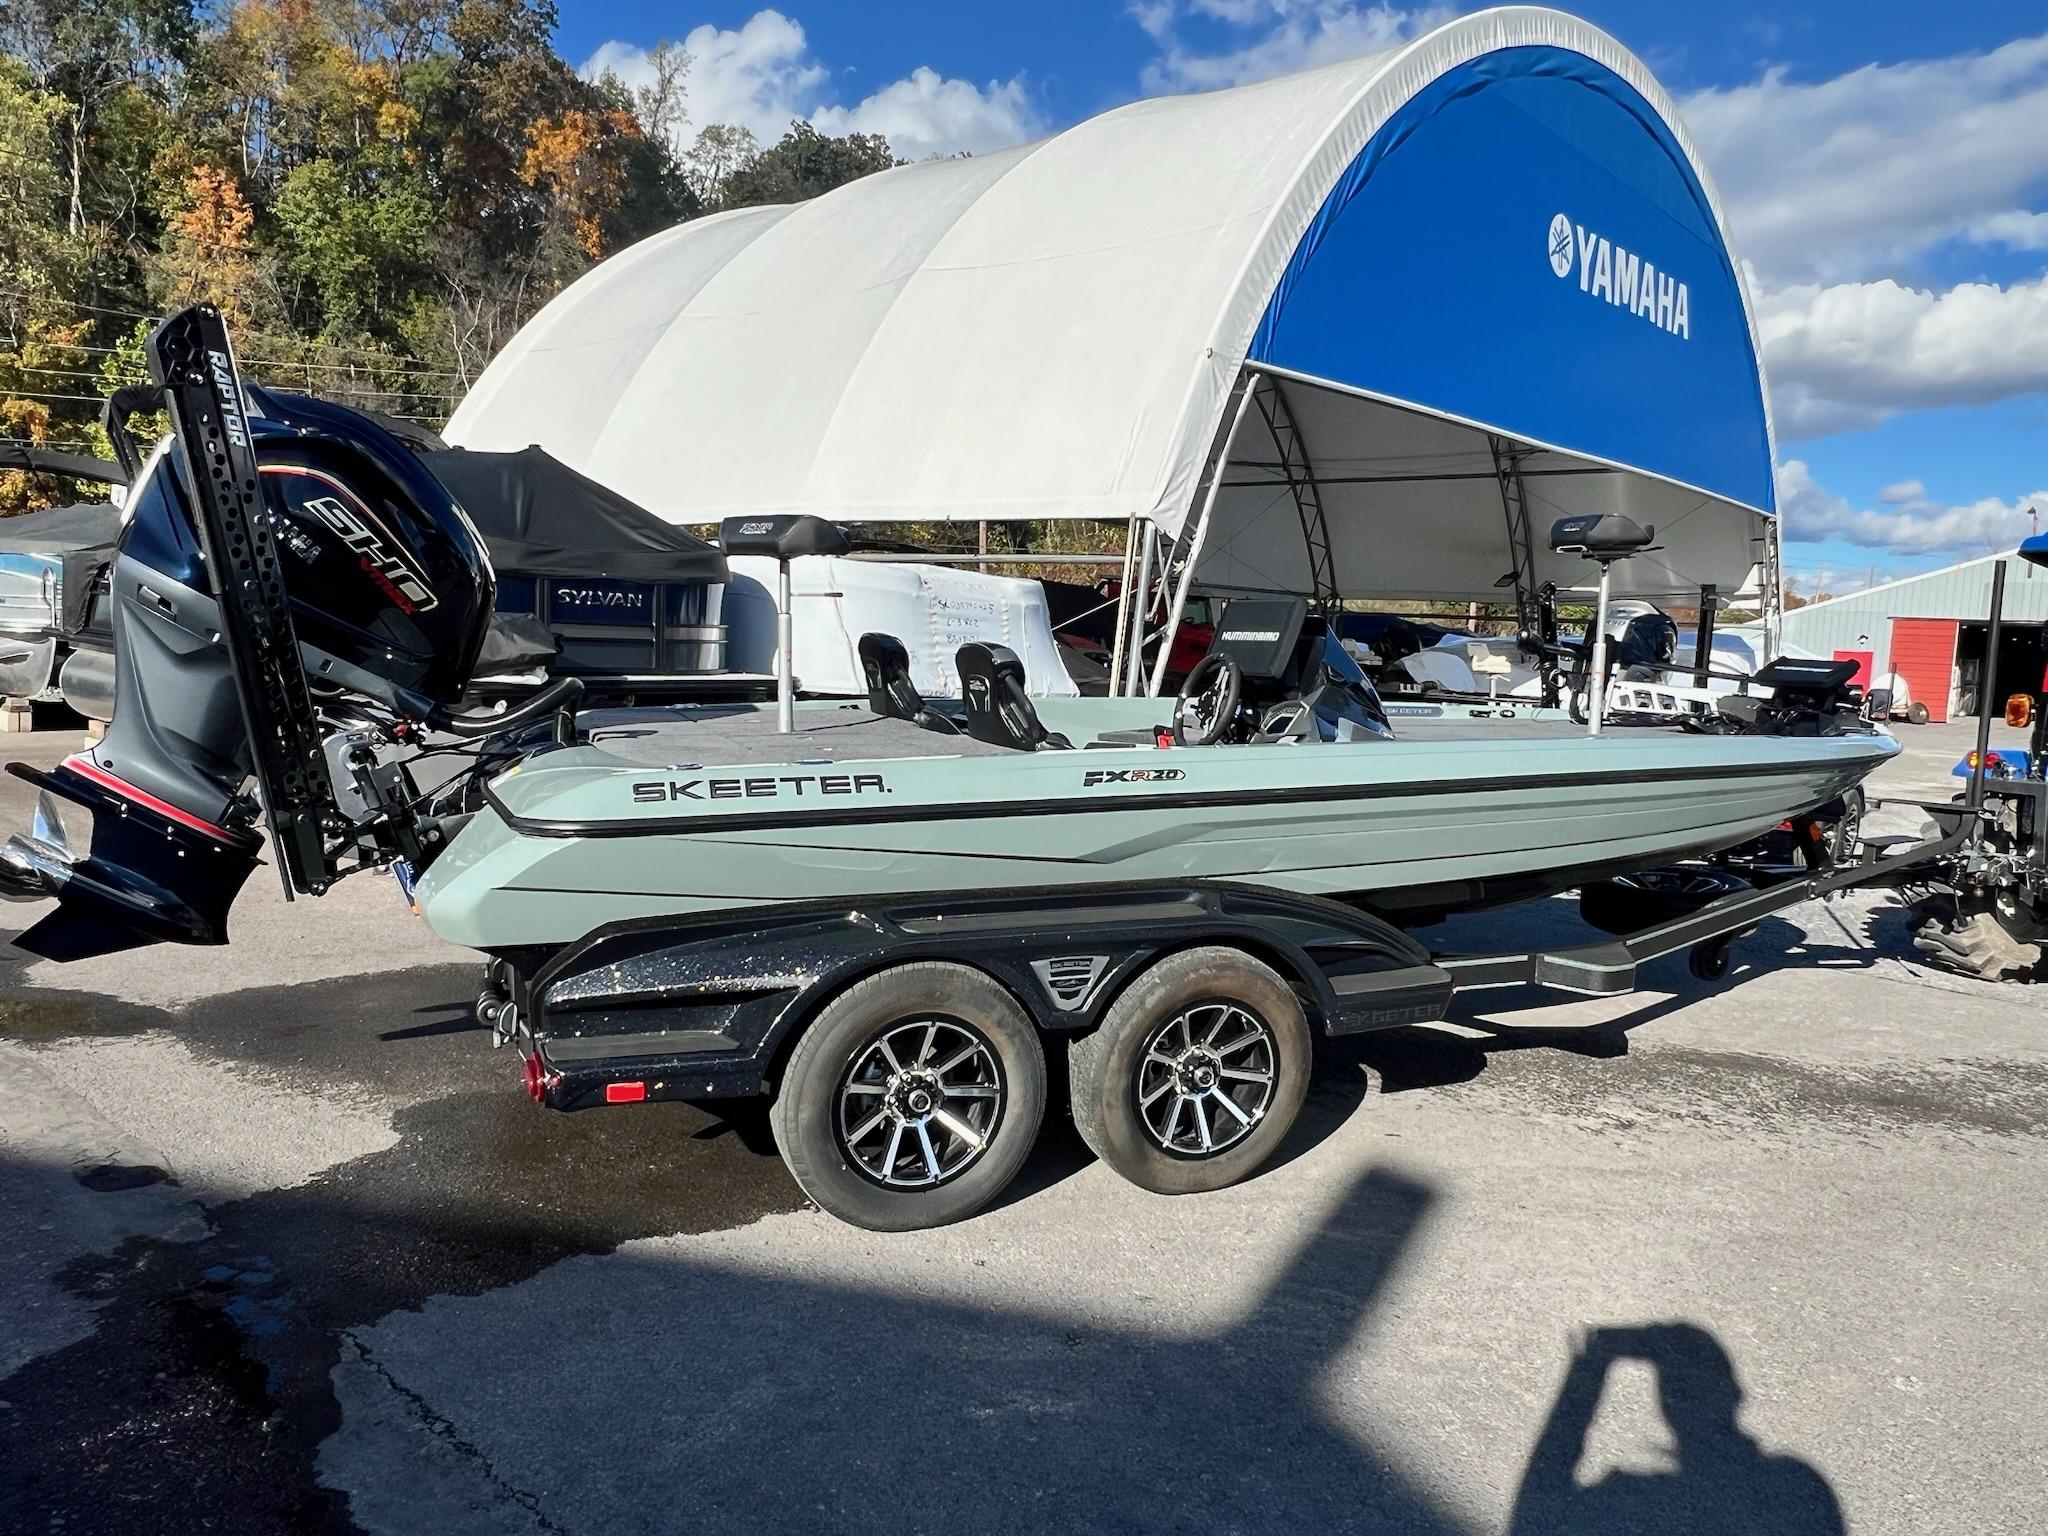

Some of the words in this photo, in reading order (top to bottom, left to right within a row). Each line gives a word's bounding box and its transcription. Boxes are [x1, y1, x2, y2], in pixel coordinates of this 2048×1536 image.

[1576, 225, 1689, 340] YAMAHA
[208, 350, 248, 448] RAPTOR
[303, 497, 439, 612] SHO
[558, 589, 643, 607] SYLVAN
[1221, 631, 1280, 642] HUMMINBIRD
[1386, 707, 1433, 715] SKEETER
[1343, 1003, 1441, 1031] SKEETER
